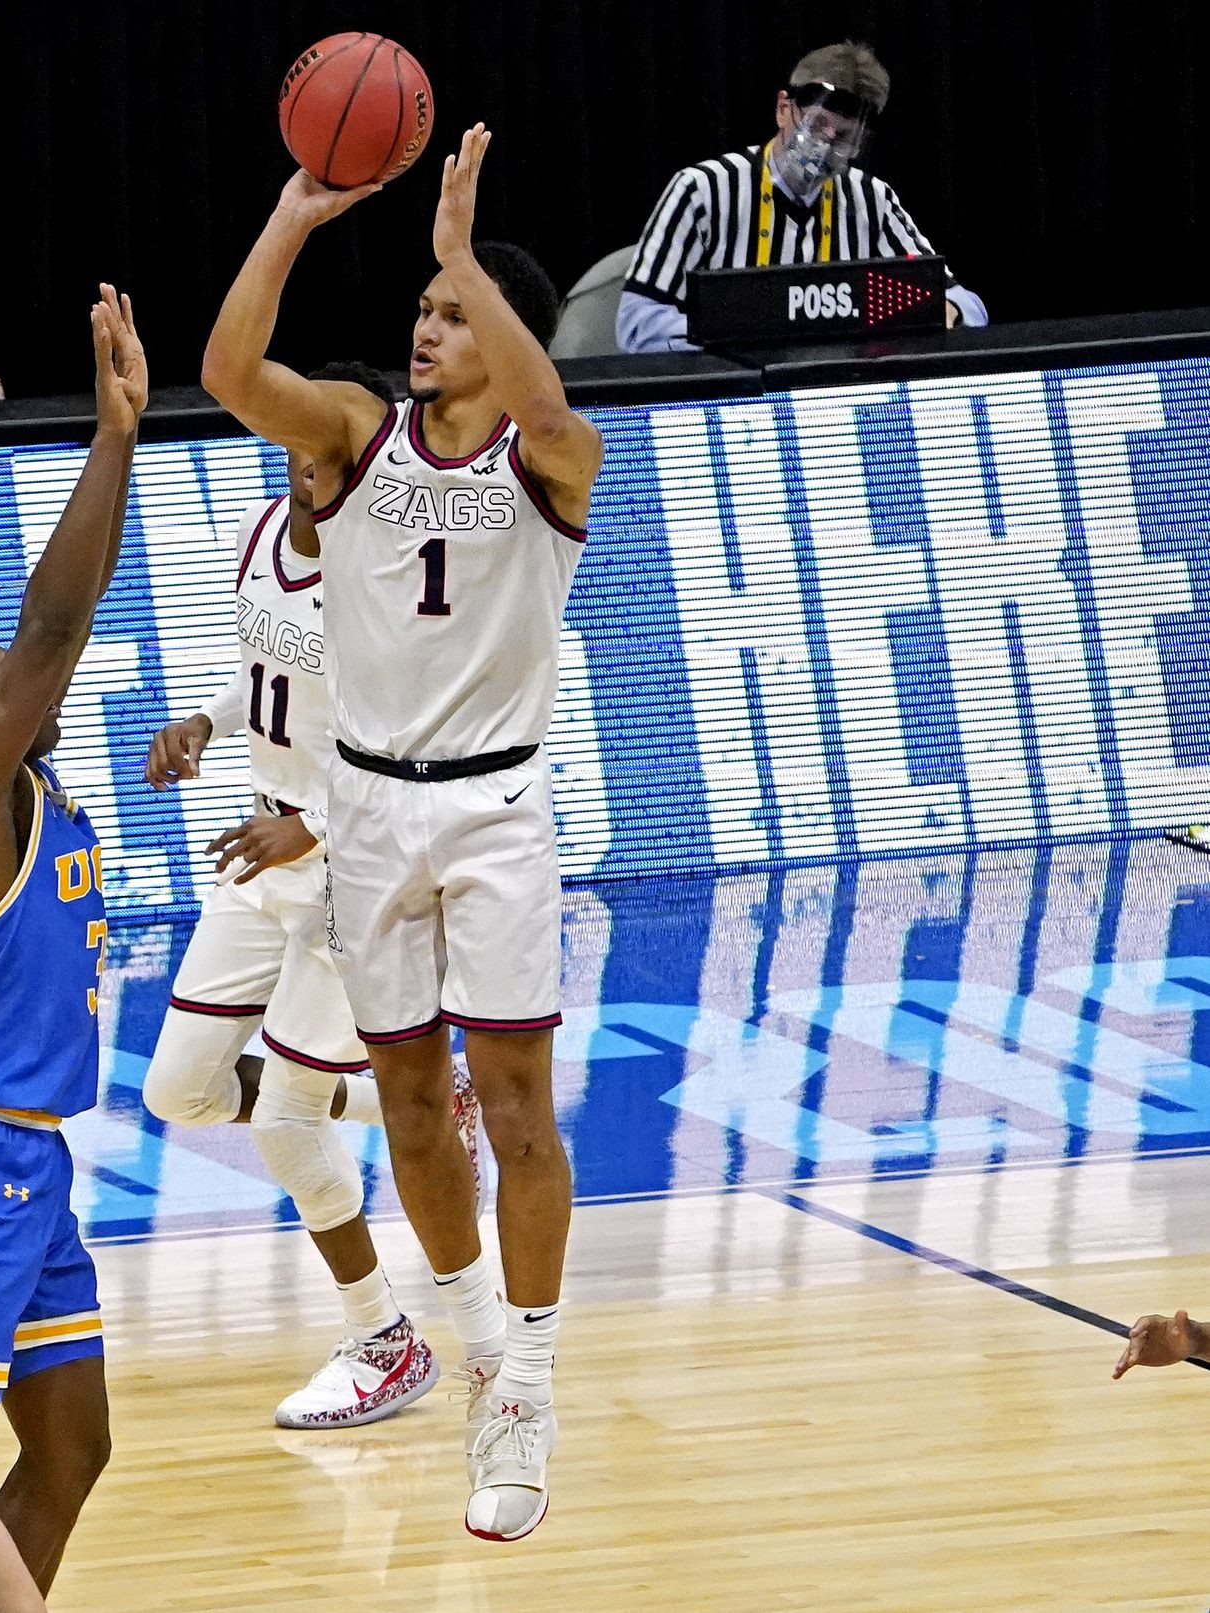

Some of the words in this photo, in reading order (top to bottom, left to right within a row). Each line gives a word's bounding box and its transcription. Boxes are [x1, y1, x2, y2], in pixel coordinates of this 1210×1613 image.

[788, 281, 860, 322] POSS.
[368, 475, 516, 531] ZAGS
[417, 538, 452, 616] 1
[237, 596, 325, 676] ZAGS
[649, 371, 1210, 863] HERE
[248, 662, 292, 749] 11
